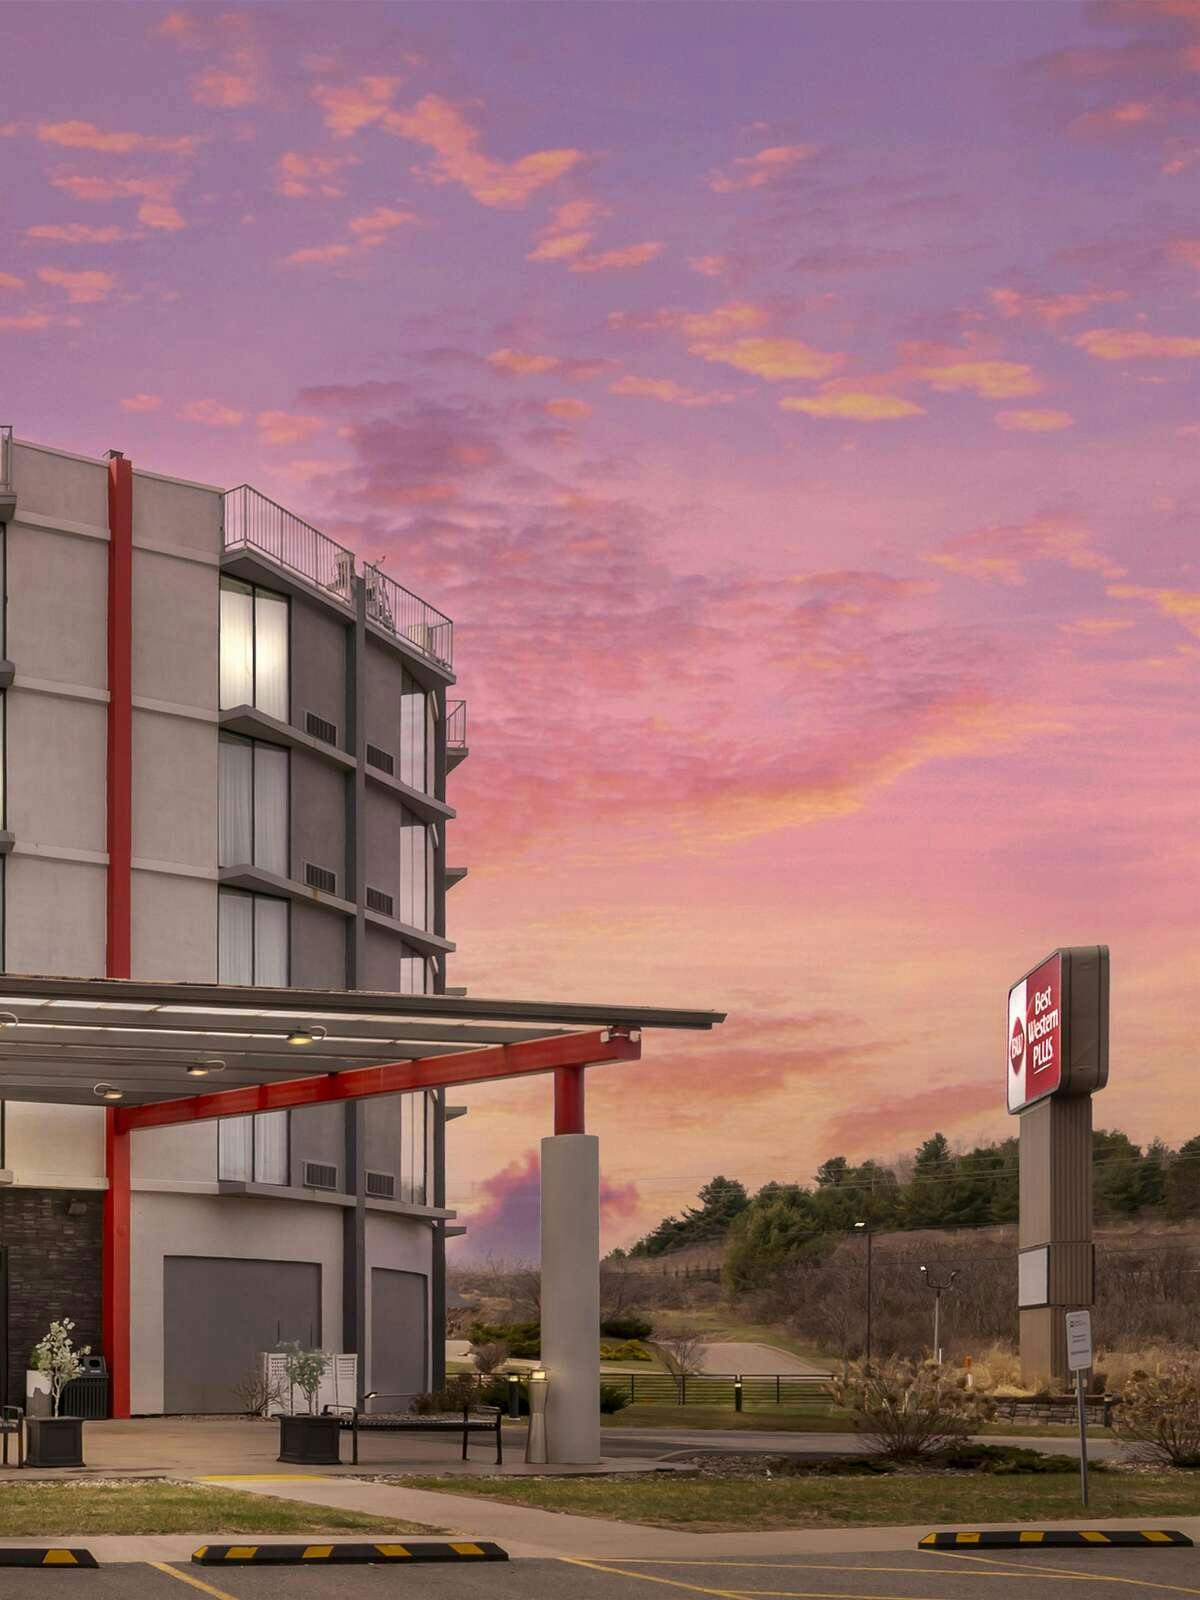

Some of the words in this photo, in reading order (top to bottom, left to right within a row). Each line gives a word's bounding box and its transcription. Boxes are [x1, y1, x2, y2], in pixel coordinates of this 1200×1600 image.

[1035, 985, 1052, 1016] Best
[1028, 1008, 1059, 1045] Western
[1032, 1036, 1054, 1069] PLUS
